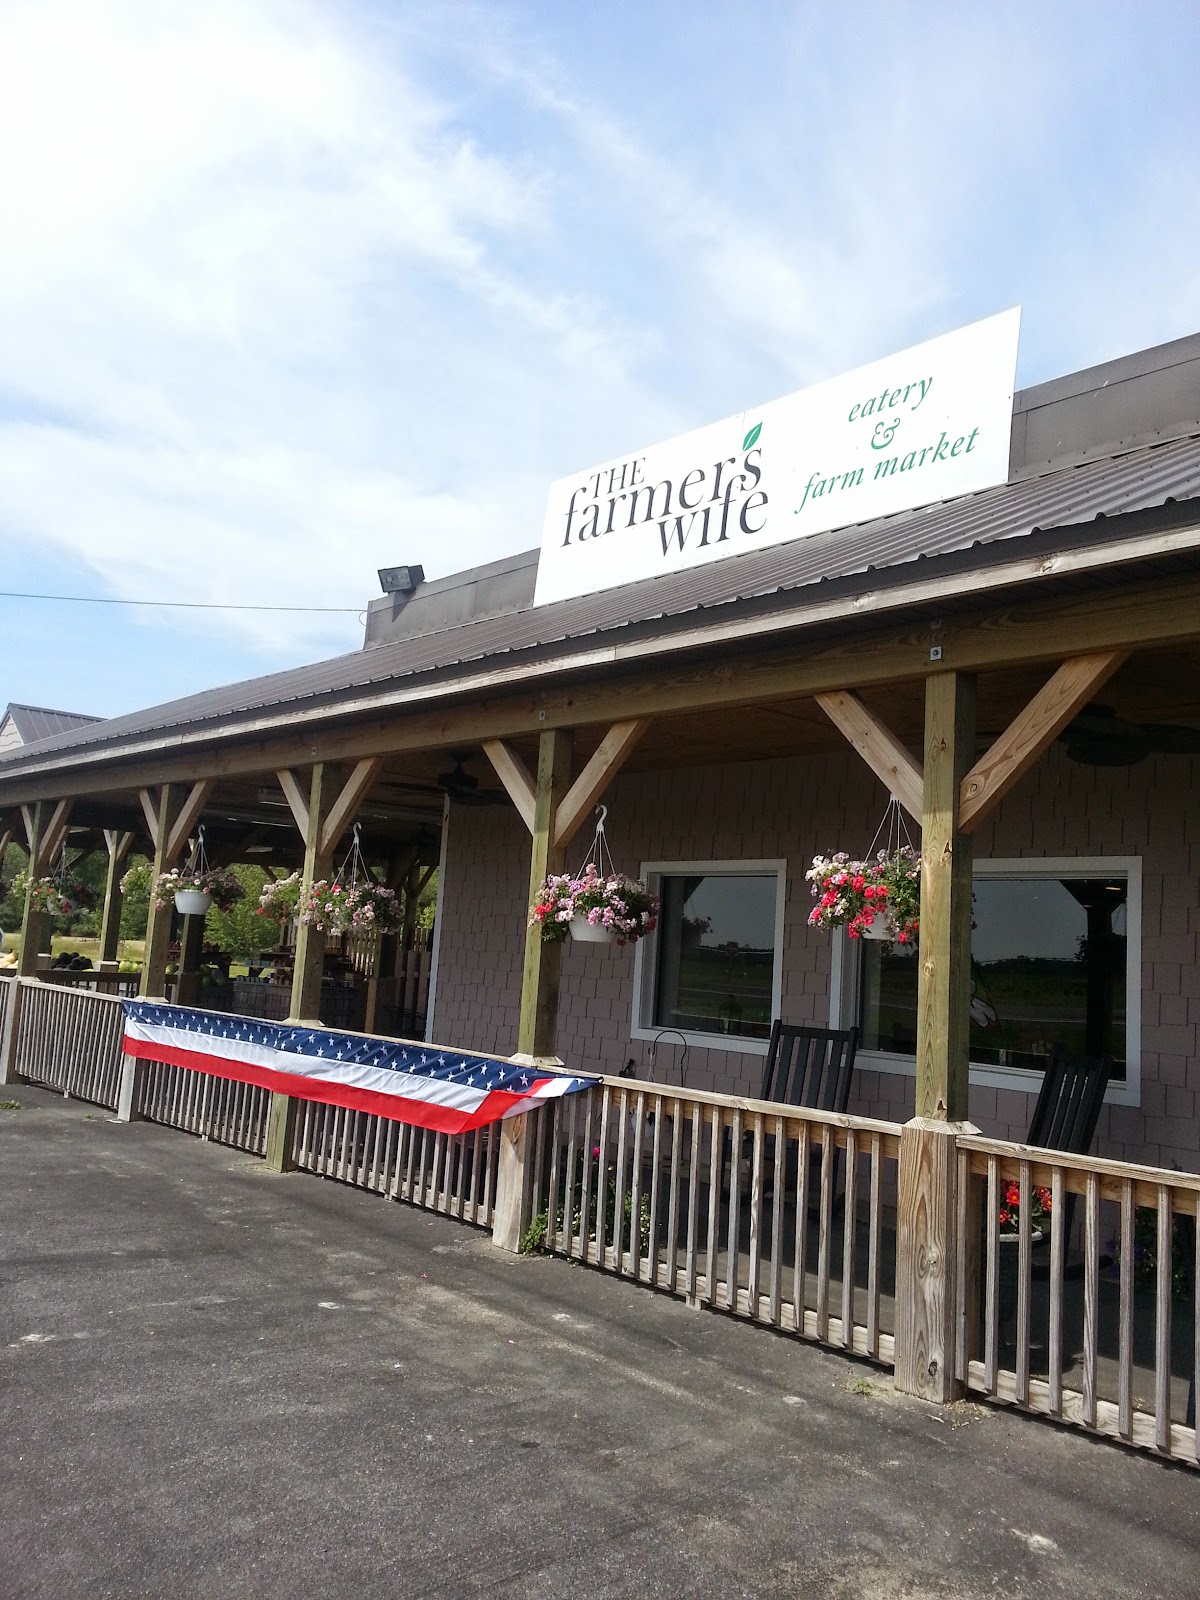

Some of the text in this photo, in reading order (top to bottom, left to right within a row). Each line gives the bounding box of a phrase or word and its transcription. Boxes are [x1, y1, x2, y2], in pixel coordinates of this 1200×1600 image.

[848, 376, 933, 422] eatery
[870, 417, 901, 450] &
[589, 457, 646, 499] THE
[794, 426, 980, 515] farm market
[656, 474, 769, 557] wife
